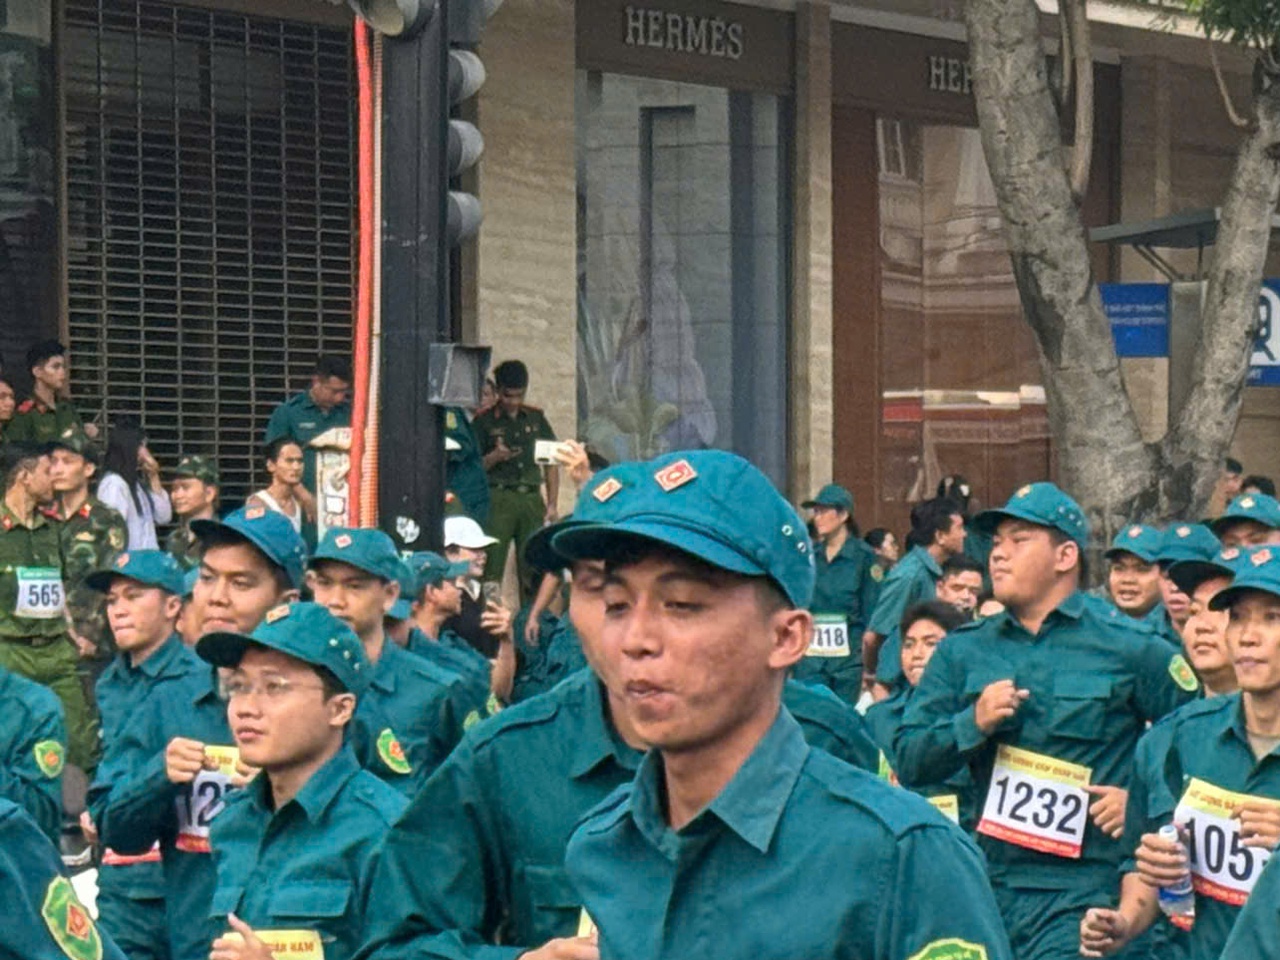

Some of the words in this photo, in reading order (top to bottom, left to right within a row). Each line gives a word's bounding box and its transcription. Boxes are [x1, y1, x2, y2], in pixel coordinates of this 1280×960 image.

[28, 583, 60, 607] 565
[995, 776, 1082, 836] 1232
[1184, 817, 1267, 881] 105
